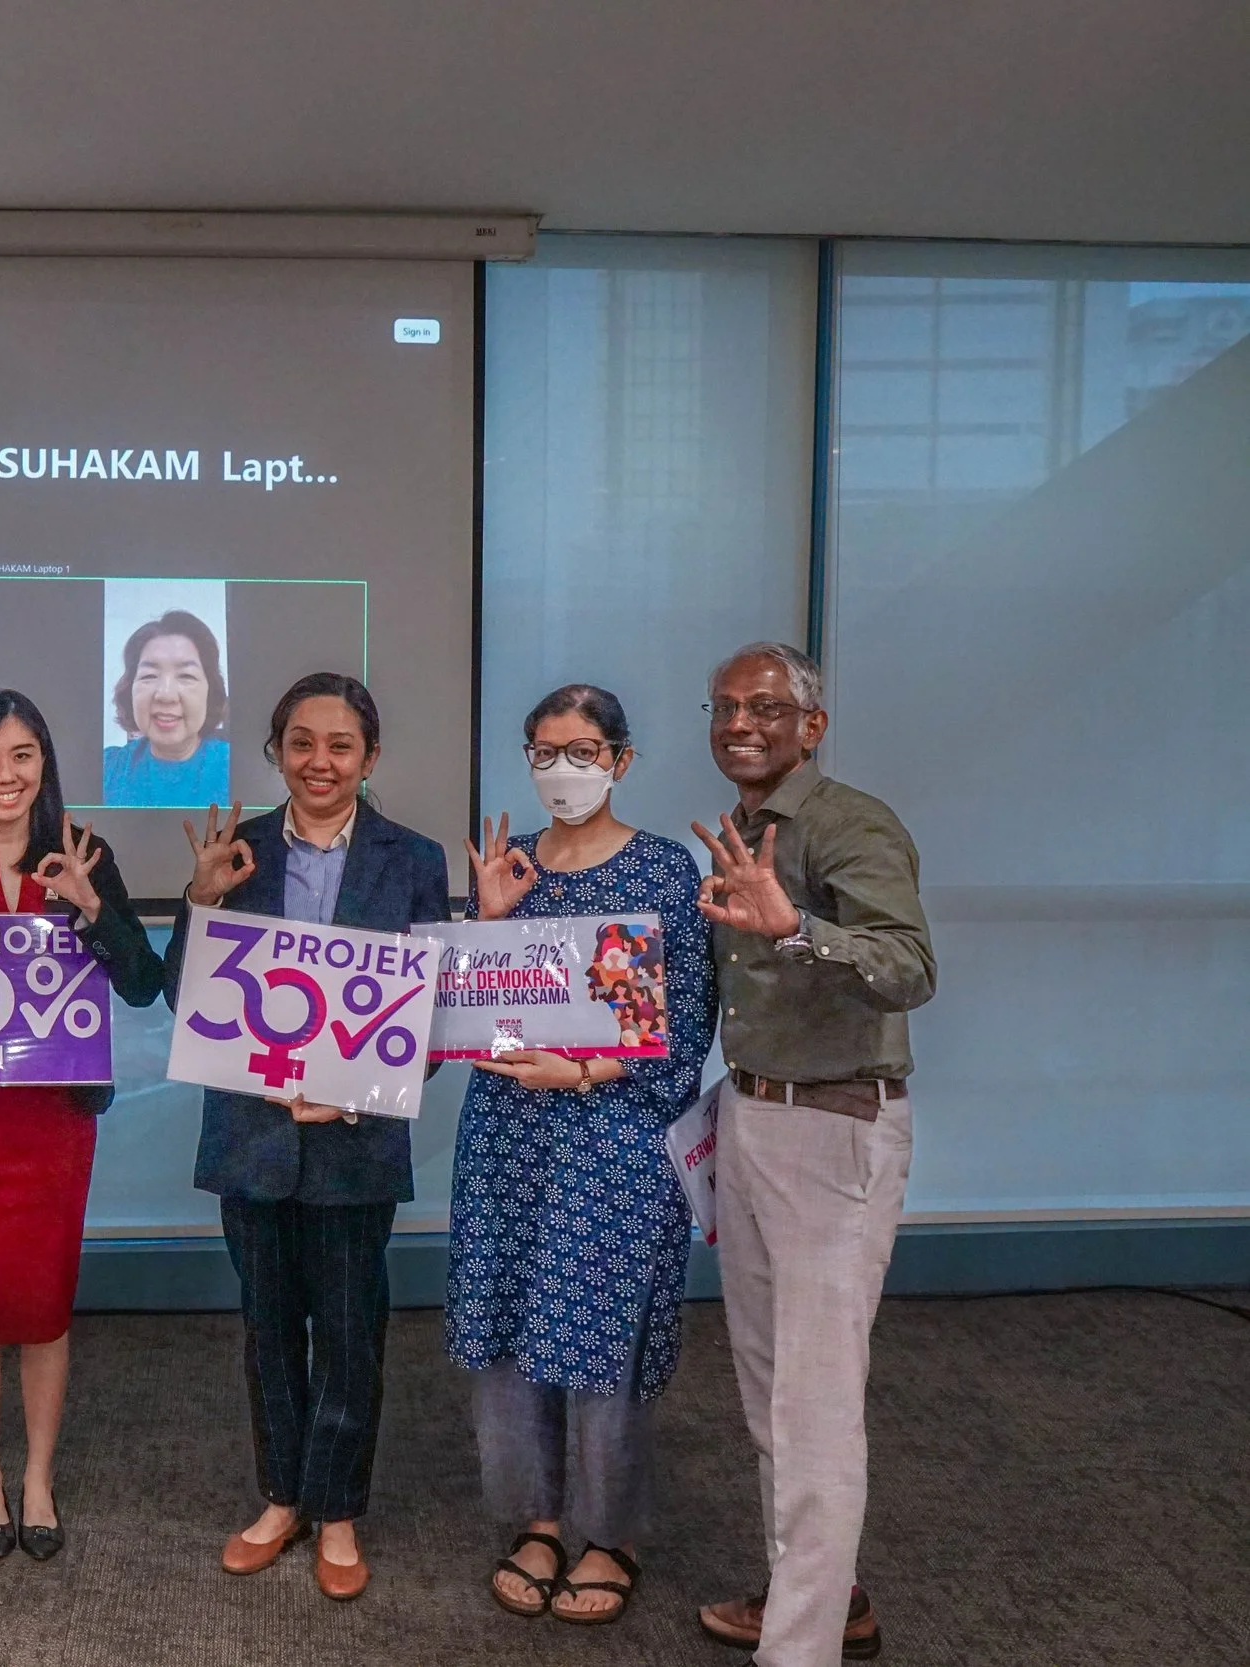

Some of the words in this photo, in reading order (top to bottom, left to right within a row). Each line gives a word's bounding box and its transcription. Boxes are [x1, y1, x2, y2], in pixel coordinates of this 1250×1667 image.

[403, 327, 421, 338] Sign
[423, 327, 431, 336] in
[223, 450, 339, 491] Lapt...
[33, 564, 64, 575] Laptop
[552, 798, 567, 806] 3M
[272, 930, 429, 980] PROJEK
[523, 941, 565, 969] 30%
[186, 919, 427, 1089] 30%
[460, 988, 499, 1007] LEBIH
[502, 986, 571, 1006] SAKSAMA
